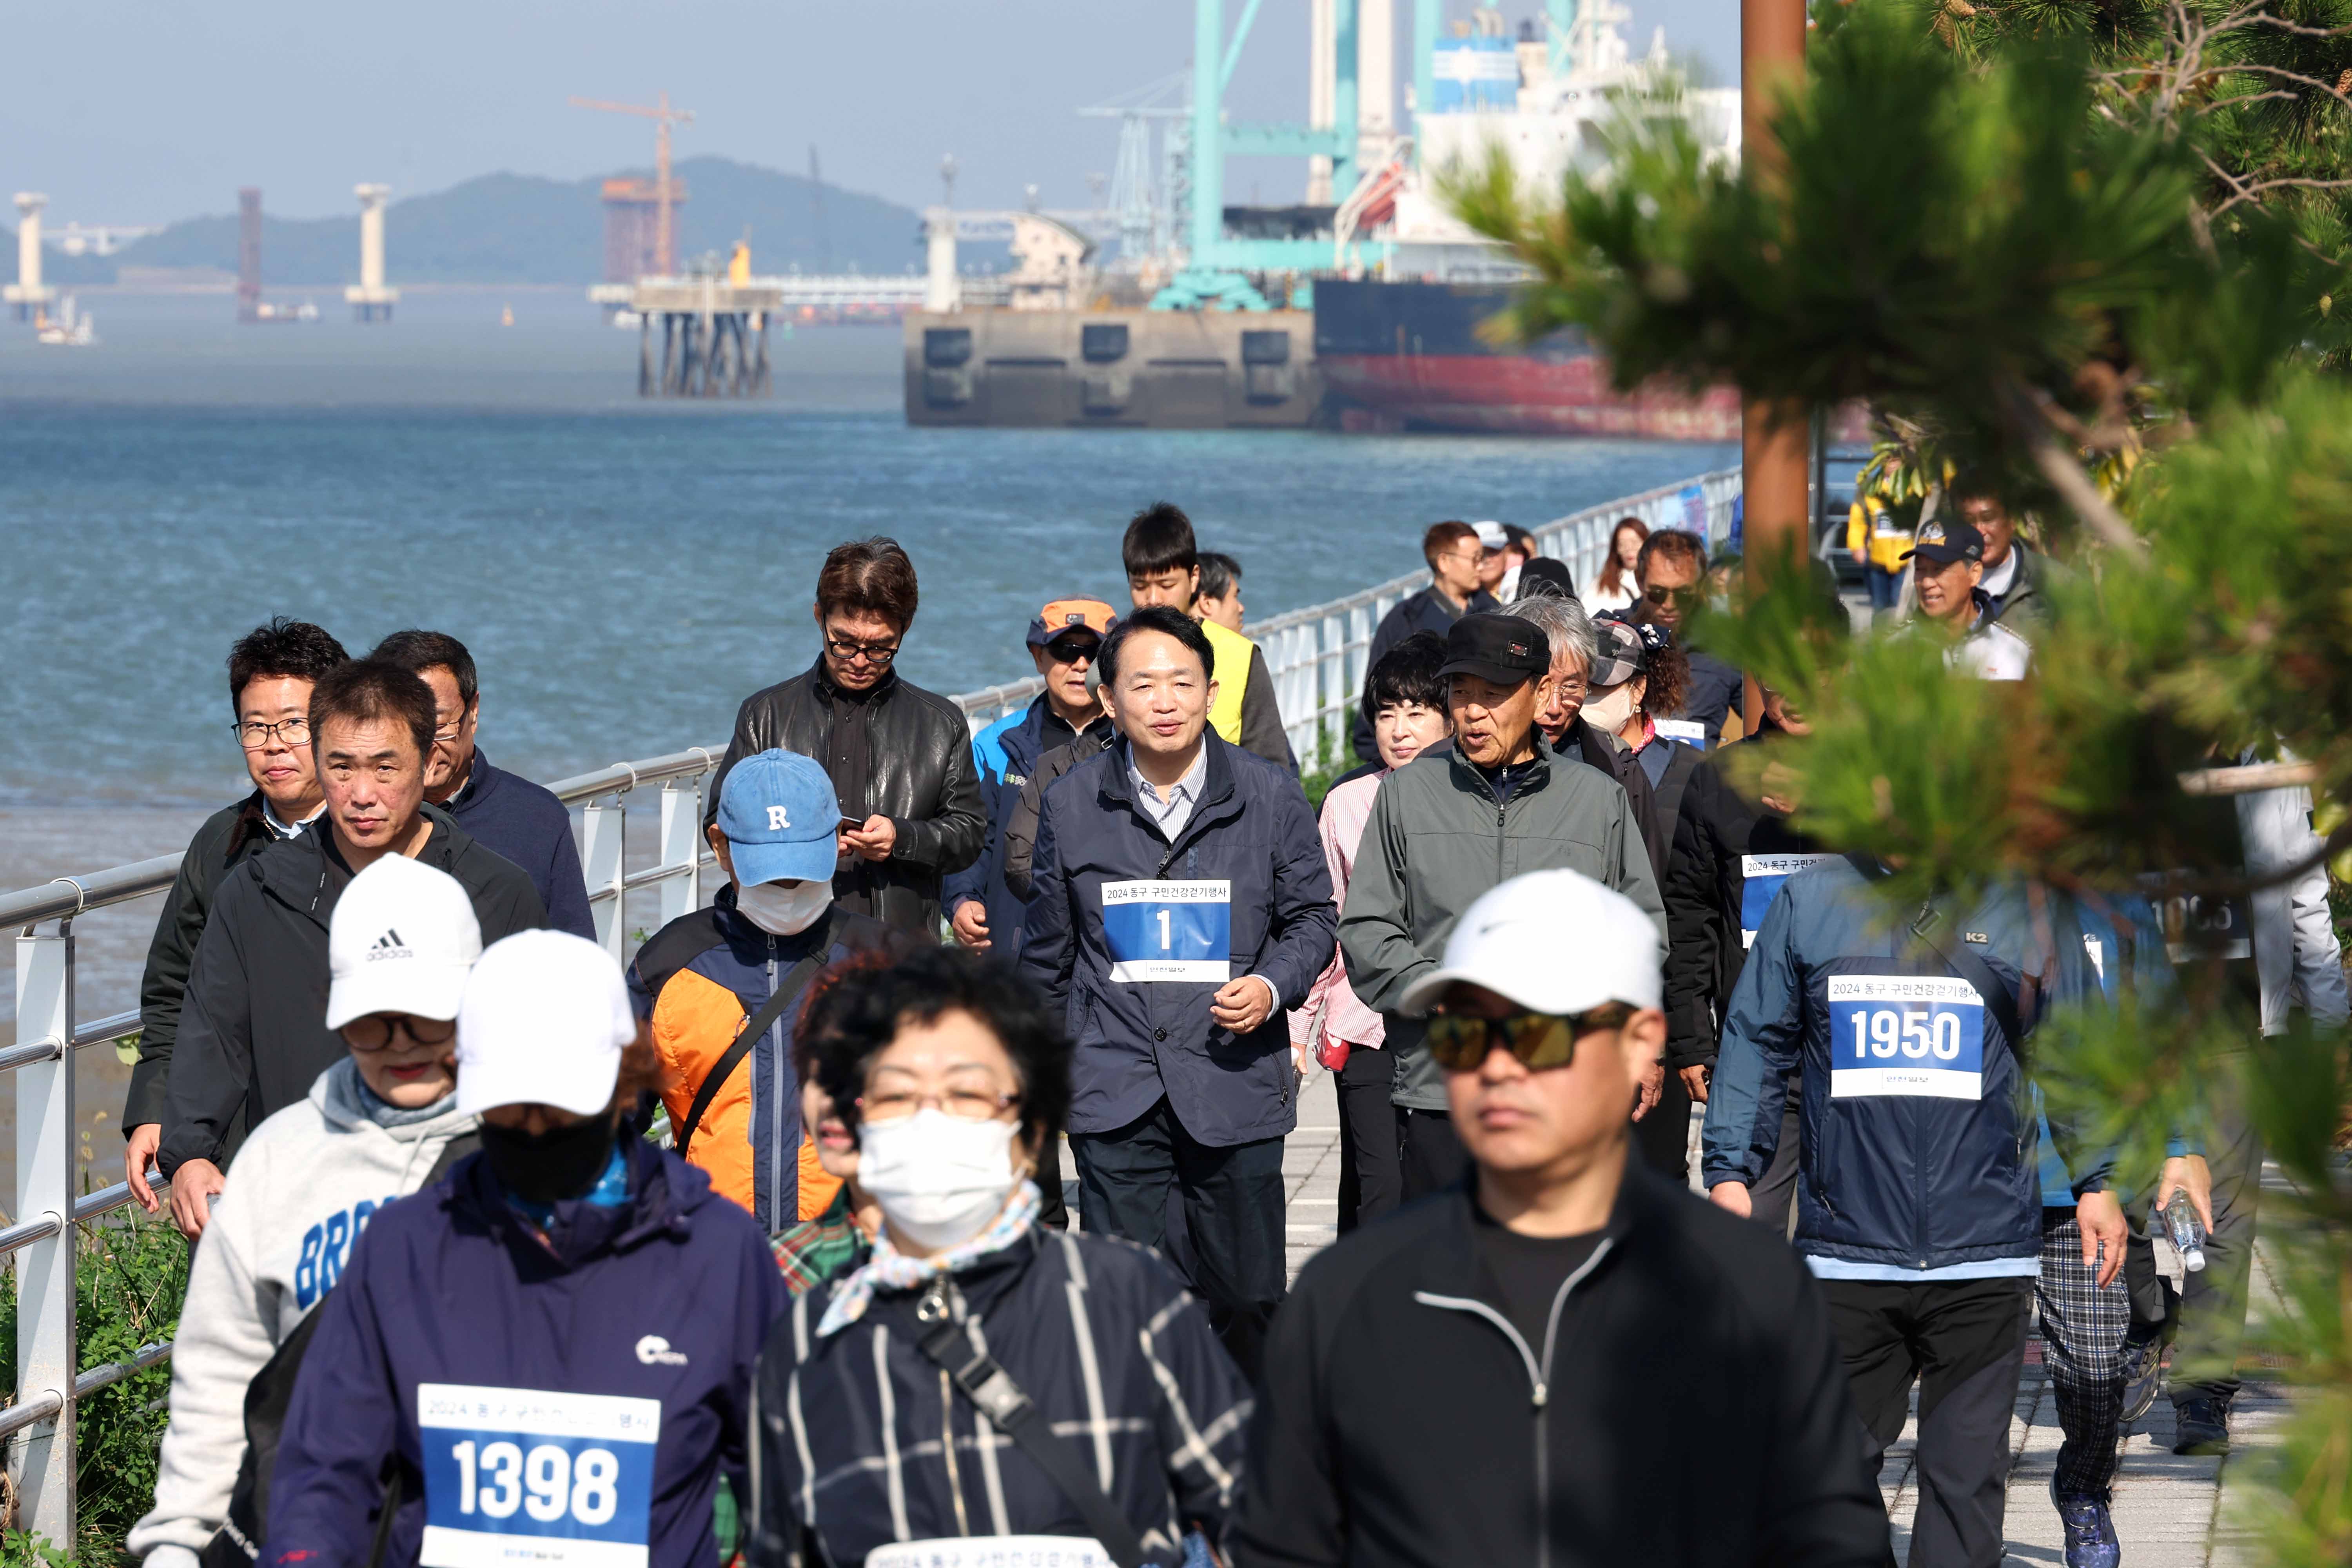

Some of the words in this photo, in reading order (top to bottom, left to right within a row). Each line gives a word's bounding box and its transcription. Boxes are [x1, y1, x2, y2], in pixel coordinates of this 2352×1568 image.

[766, 806, 790, 830] R
[1748, 861, 1768, 871] 2024
[1771, 860, 1788, 870] 동구
[1107, 888, 1128, 899] 2024
[1130, 887, 1148, 898] 동구
[1151, 887, 1227, 898] 구민건강걷기행사
[1157, 910, 1170, 949] 1
[1966, 932, 1987, 942] K2
[366, 949, 414, 962] adidas
[1833, 984, 1860, 994] 2024
[1864, 983, 1886, 995] 동구
[1891, 984, 1977, 999] 구민건강걷기행사
[1851, 1010, 1961, 1060] 1950
[452, 1440, 619, 1525] 1398
